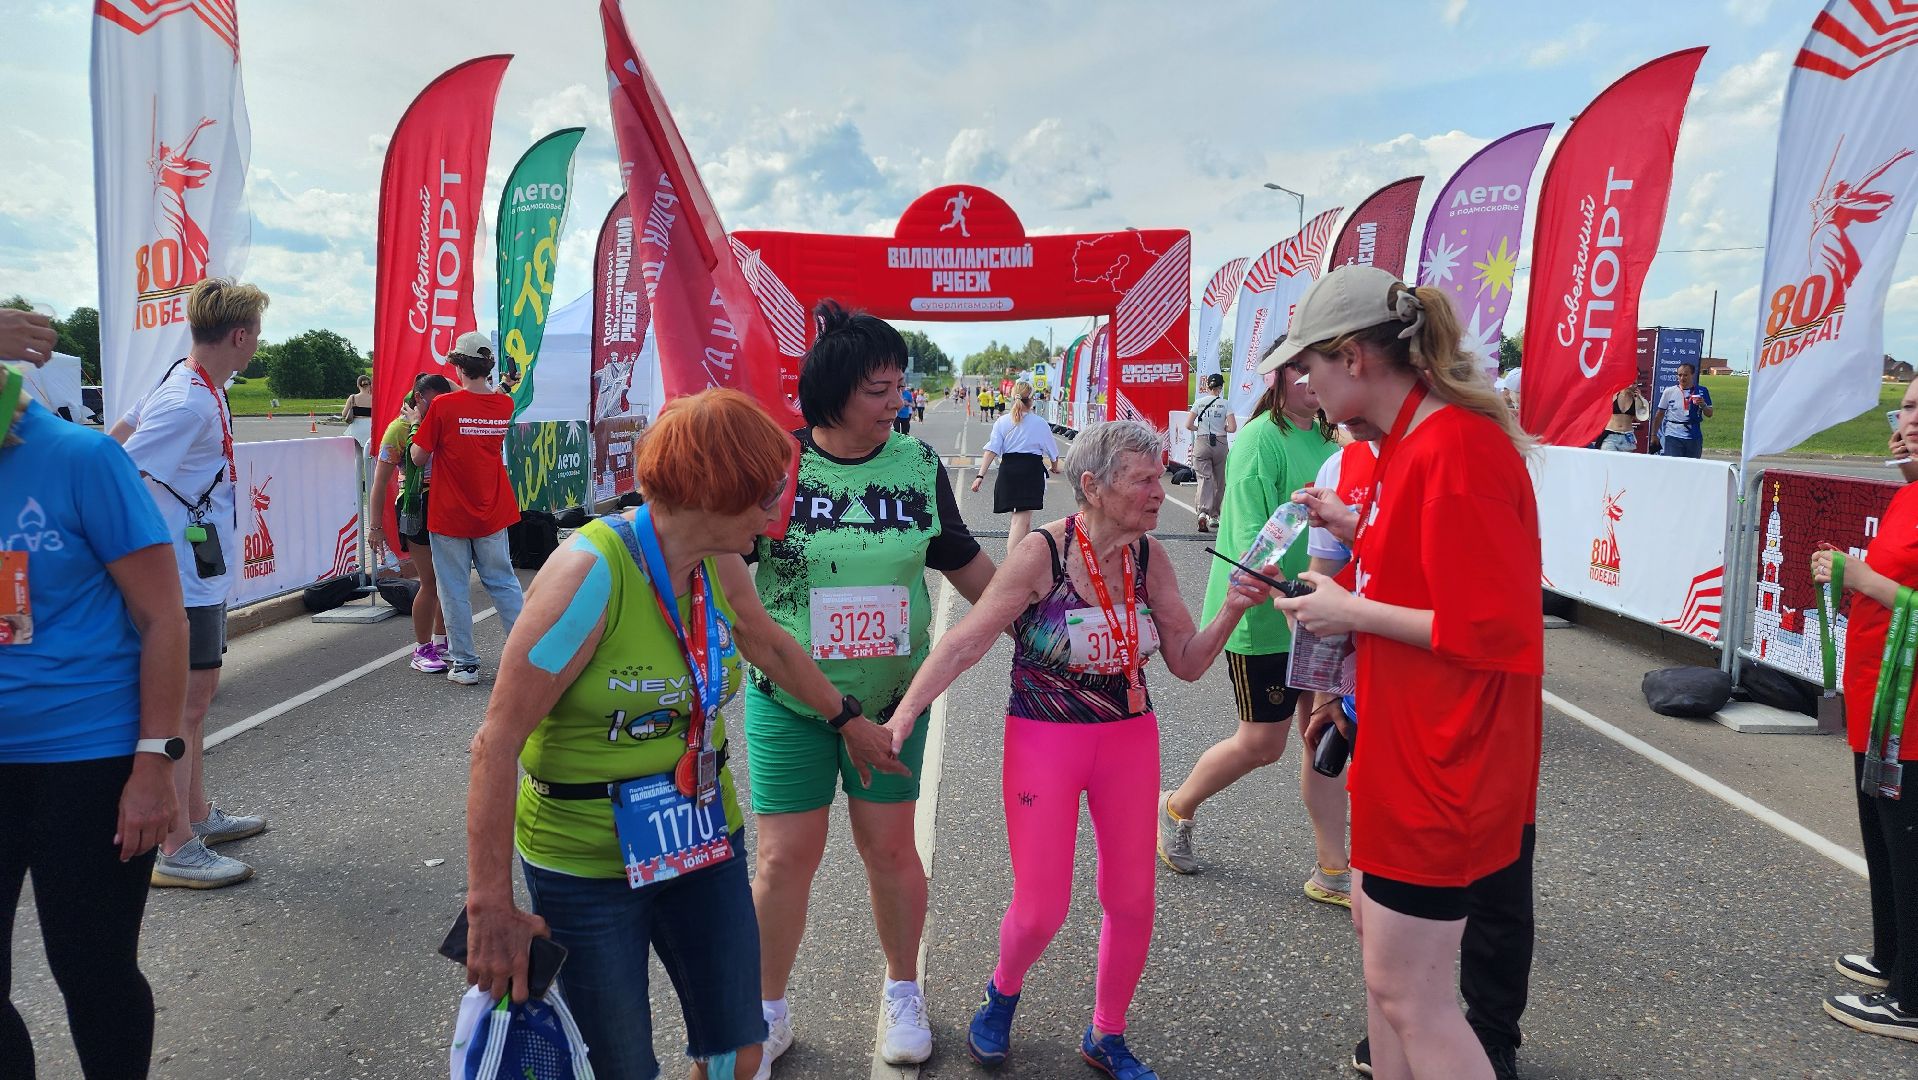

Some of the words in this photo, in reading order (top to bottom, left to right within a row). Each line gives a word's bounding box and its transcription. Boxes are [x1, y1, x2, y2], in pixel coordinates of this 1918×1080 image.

[136, 238, 179, 294] 80
[408, 185, 431, 334] Советский
[431, 158, 461, 366] СПОРТ
[887, 242, 1034, 269] ВОЛОКОЛАМСКИЙ
[1557, 194, 1595, 347] Советский
[931, 270, 992, 292] РУБЕЖ
[1579, 166, 1633, 379] СПОРТ
[134, 297, 185, 331] ОБЕ
[620, 290, 638, 343] РУБЕЖ
[920, 298, 1004, 311] суперлигамо.рф
[1765, 274, 1826, 337] 80
[1121, 363, 1182, 376] МОСОБЛ
[1121, 373, 1178, 384] СПОРТ
[1591, 538, 1608, 564] 80
[243, 560, 276, 580] ПОБЕДА!
[1589, 566, 1620, 587] ПОБЕДА!
[830, 611, 886, 642] 3123
[648, 802, 714, 852] 1170
